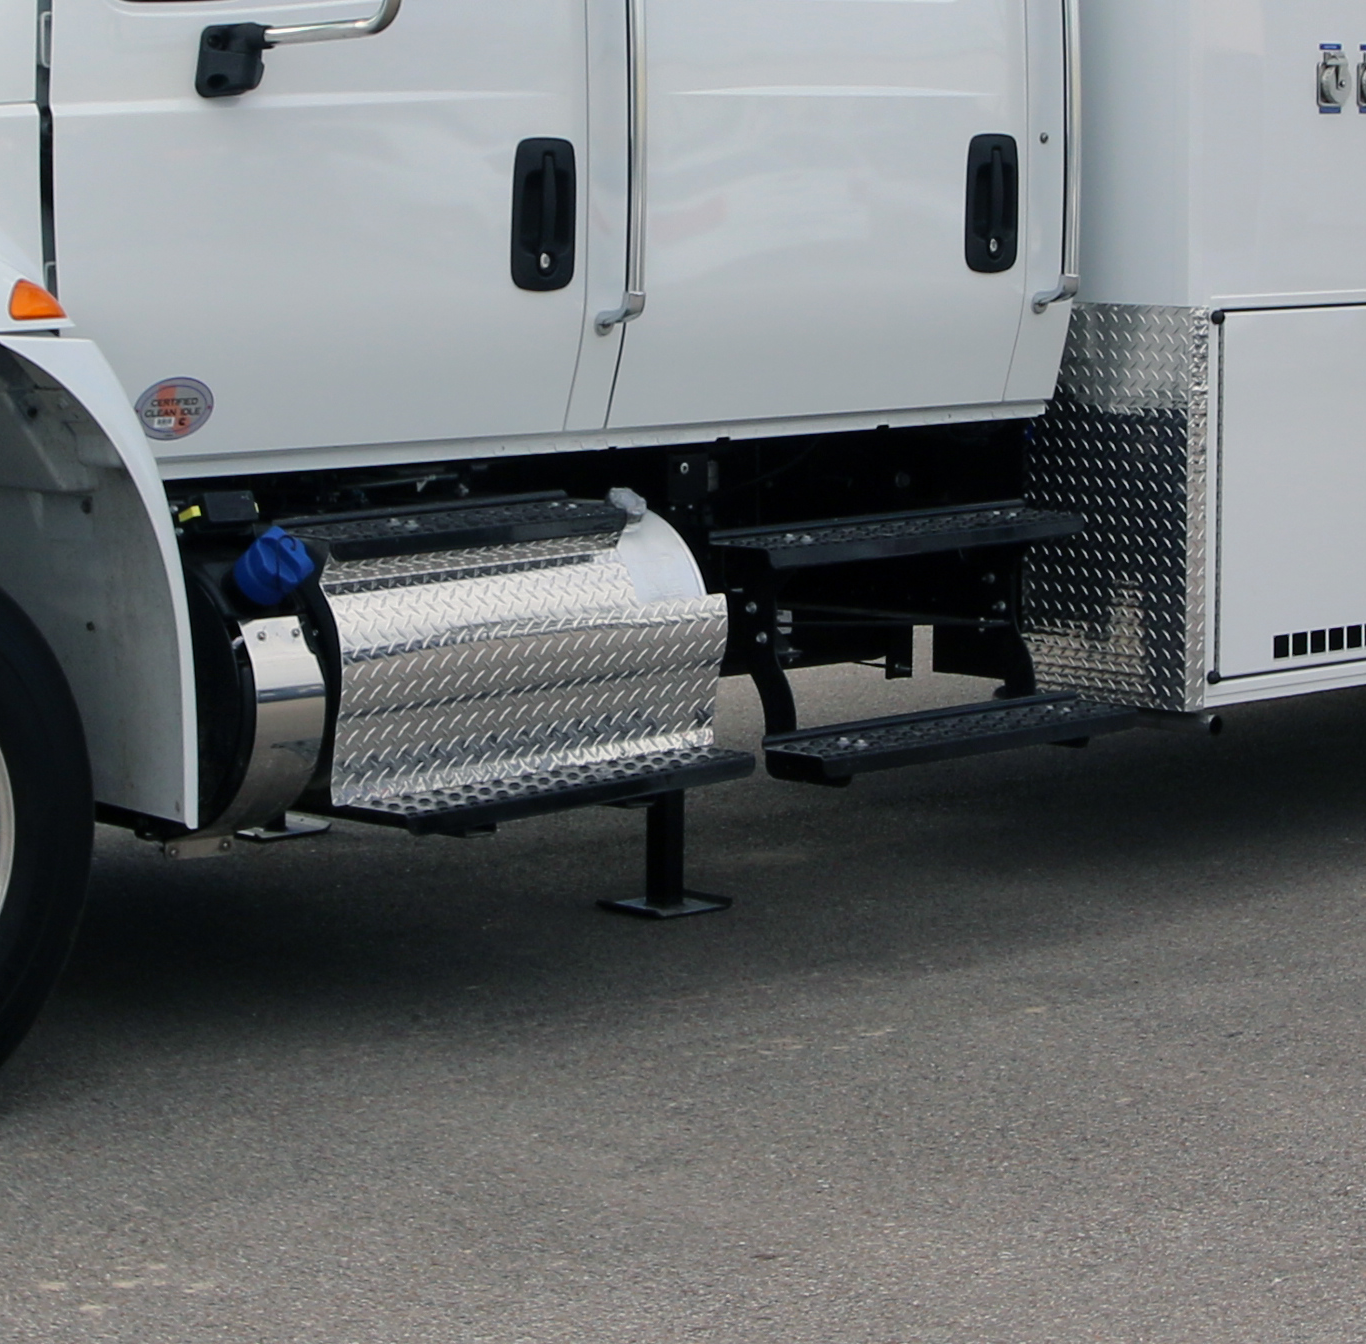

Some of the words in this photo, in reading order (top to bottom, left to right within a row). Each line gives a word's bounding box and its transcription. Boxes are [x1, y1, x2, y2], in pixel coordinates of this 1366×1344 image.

[151, 397, 199, 407] CERTIFIED
[145, 409, 177, 418] CLEAN
[180, 407, 201, 416] IDLE
